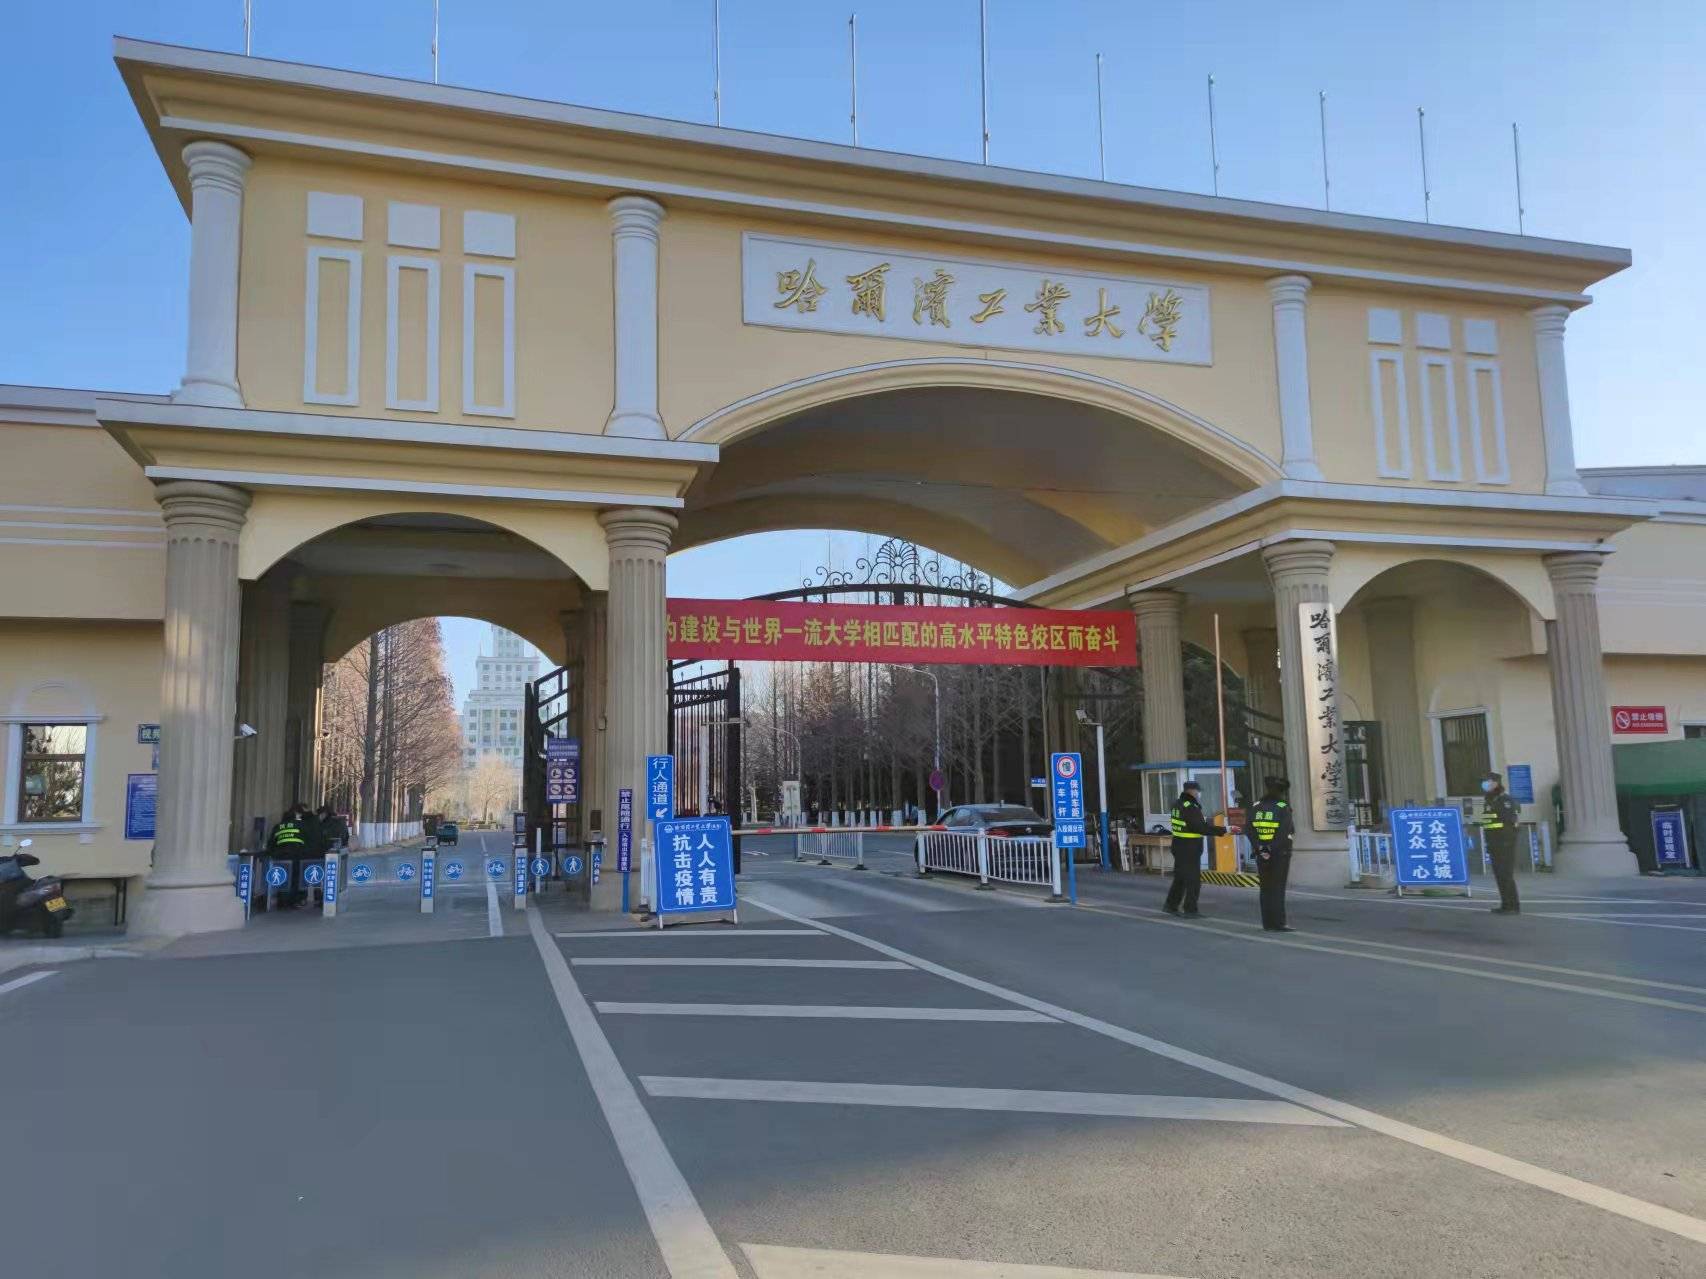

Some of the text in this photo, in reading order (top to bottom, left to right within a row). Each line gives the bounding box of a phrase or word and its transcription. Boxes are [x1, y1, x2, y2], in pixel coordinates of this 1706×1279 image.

[652, 757, 669, 805] 行人通道
[1057, 781, 1067, 817] 一车一杆
[1070, 780, 1080, 817] 保持车距
[672, 834, 694, 905] 抗击疫情
[697, 833, 718, 905] 人人有责
[1407, 821, 1430, 879] 万众一心
[1428, 820, 1453, 879] 众志成城
